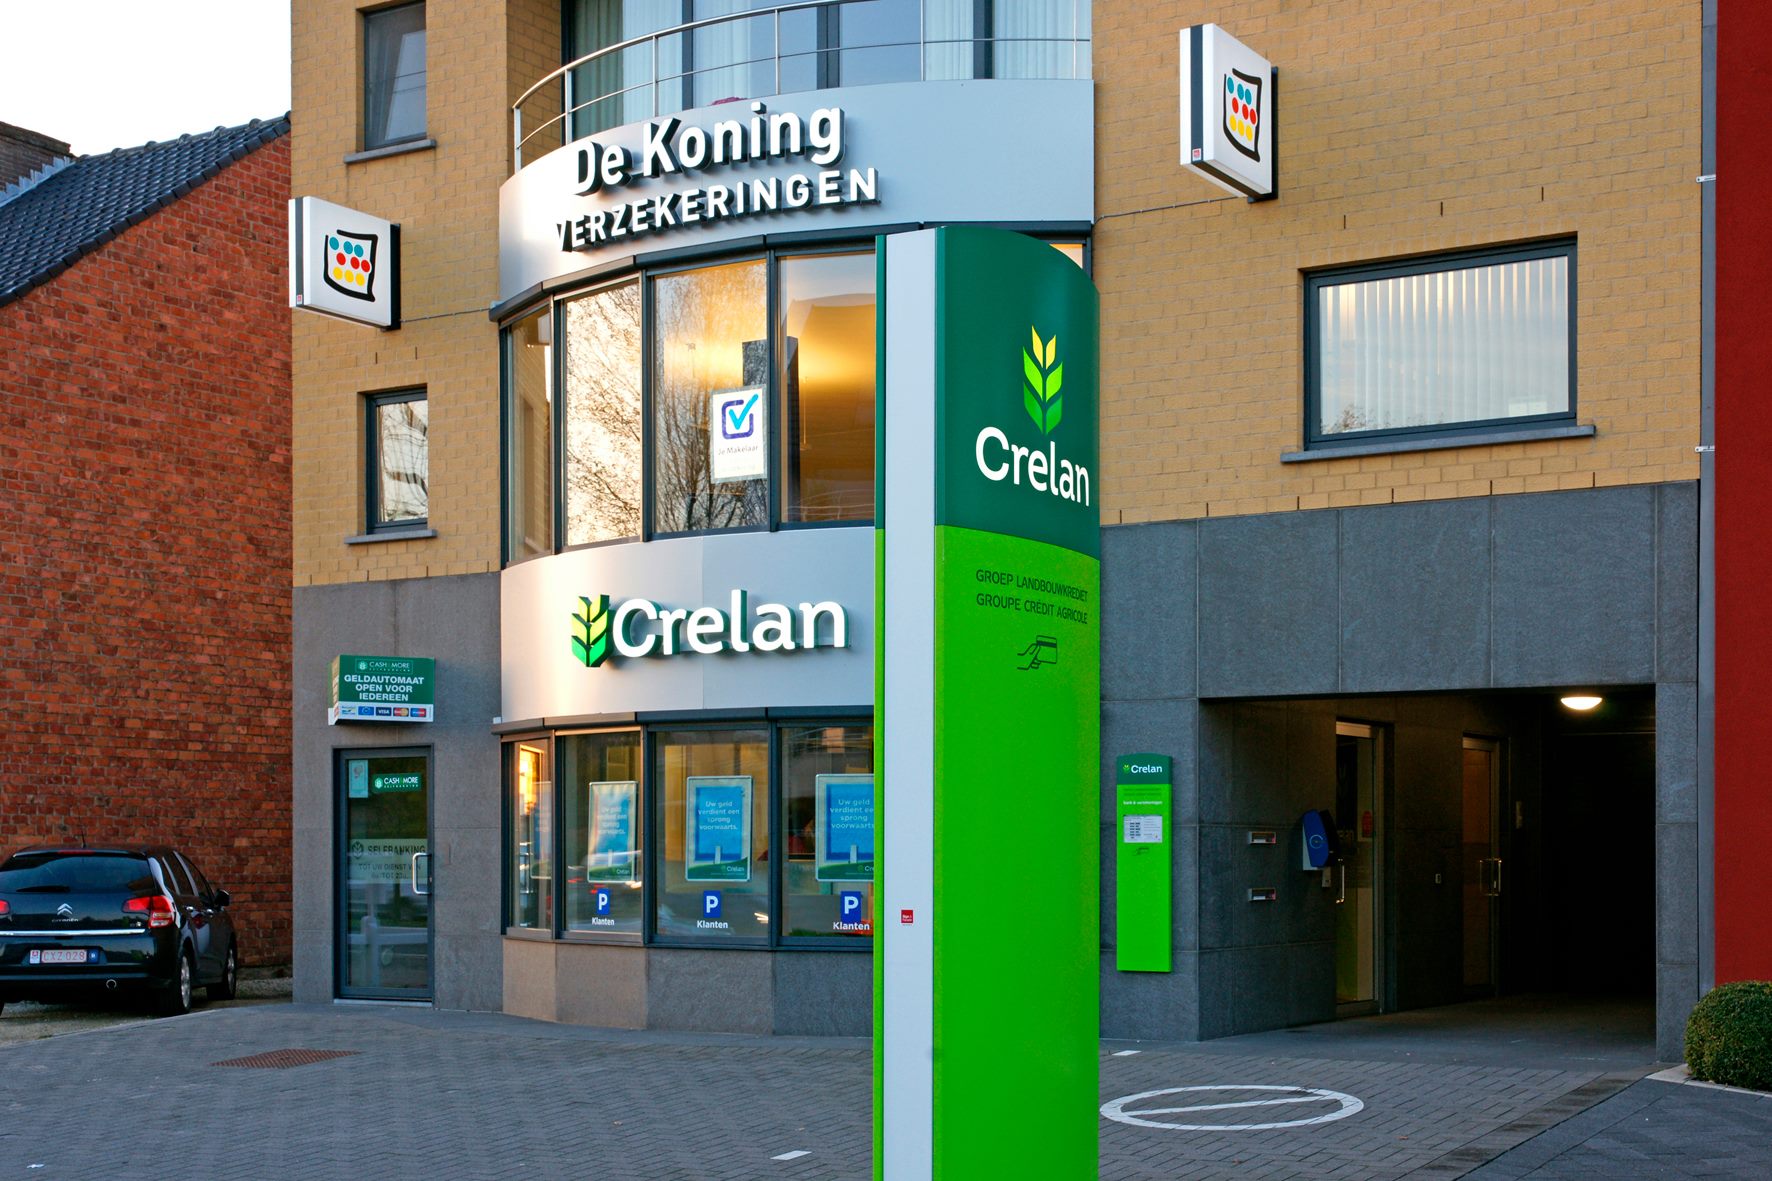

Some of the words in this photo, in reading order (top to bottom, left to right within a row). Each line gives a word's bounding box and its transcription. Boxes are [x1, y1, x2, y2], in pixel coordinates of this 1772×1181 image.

[574, 140, 632, 196] De
[642, 101, 845, 178] Koning
[556, 167, 879, 252] VERZEKERINGEN
[975, 426, 1090, 507] Crelan
[976, 569, 1014, 585] GROEP
[1016, 575, 1088, 602] LANDBOUWKREDIET
[976, 593, 1021, 611] GROUPE
[1024, 599, 1055, 616] CRÉDIT
[1056, 606, 1088, 624] AGRICOLE
[612, 589, 849, 658] Crelan
[344, 674, 424, 685] GELDAUTOMAAT
[355, 683, 383, 692] OPEN
[385, 684, 413, 693] VOOR
[359, 692, 409, 702] IEDEREEN
[1131, 764, 1163, 774] Crelan
[383, 777, 400, 785] CASH
[402, 776, 419, 784] MORE
[598, 893, 608, 910] P
[705, 895, 719, 913] P
[844, 895, 859, 914] P
[591, 917, 615, 926] Klanten
[696, 920, 729, 929] Klanten
[832, 922, 870, 931] Klanten
